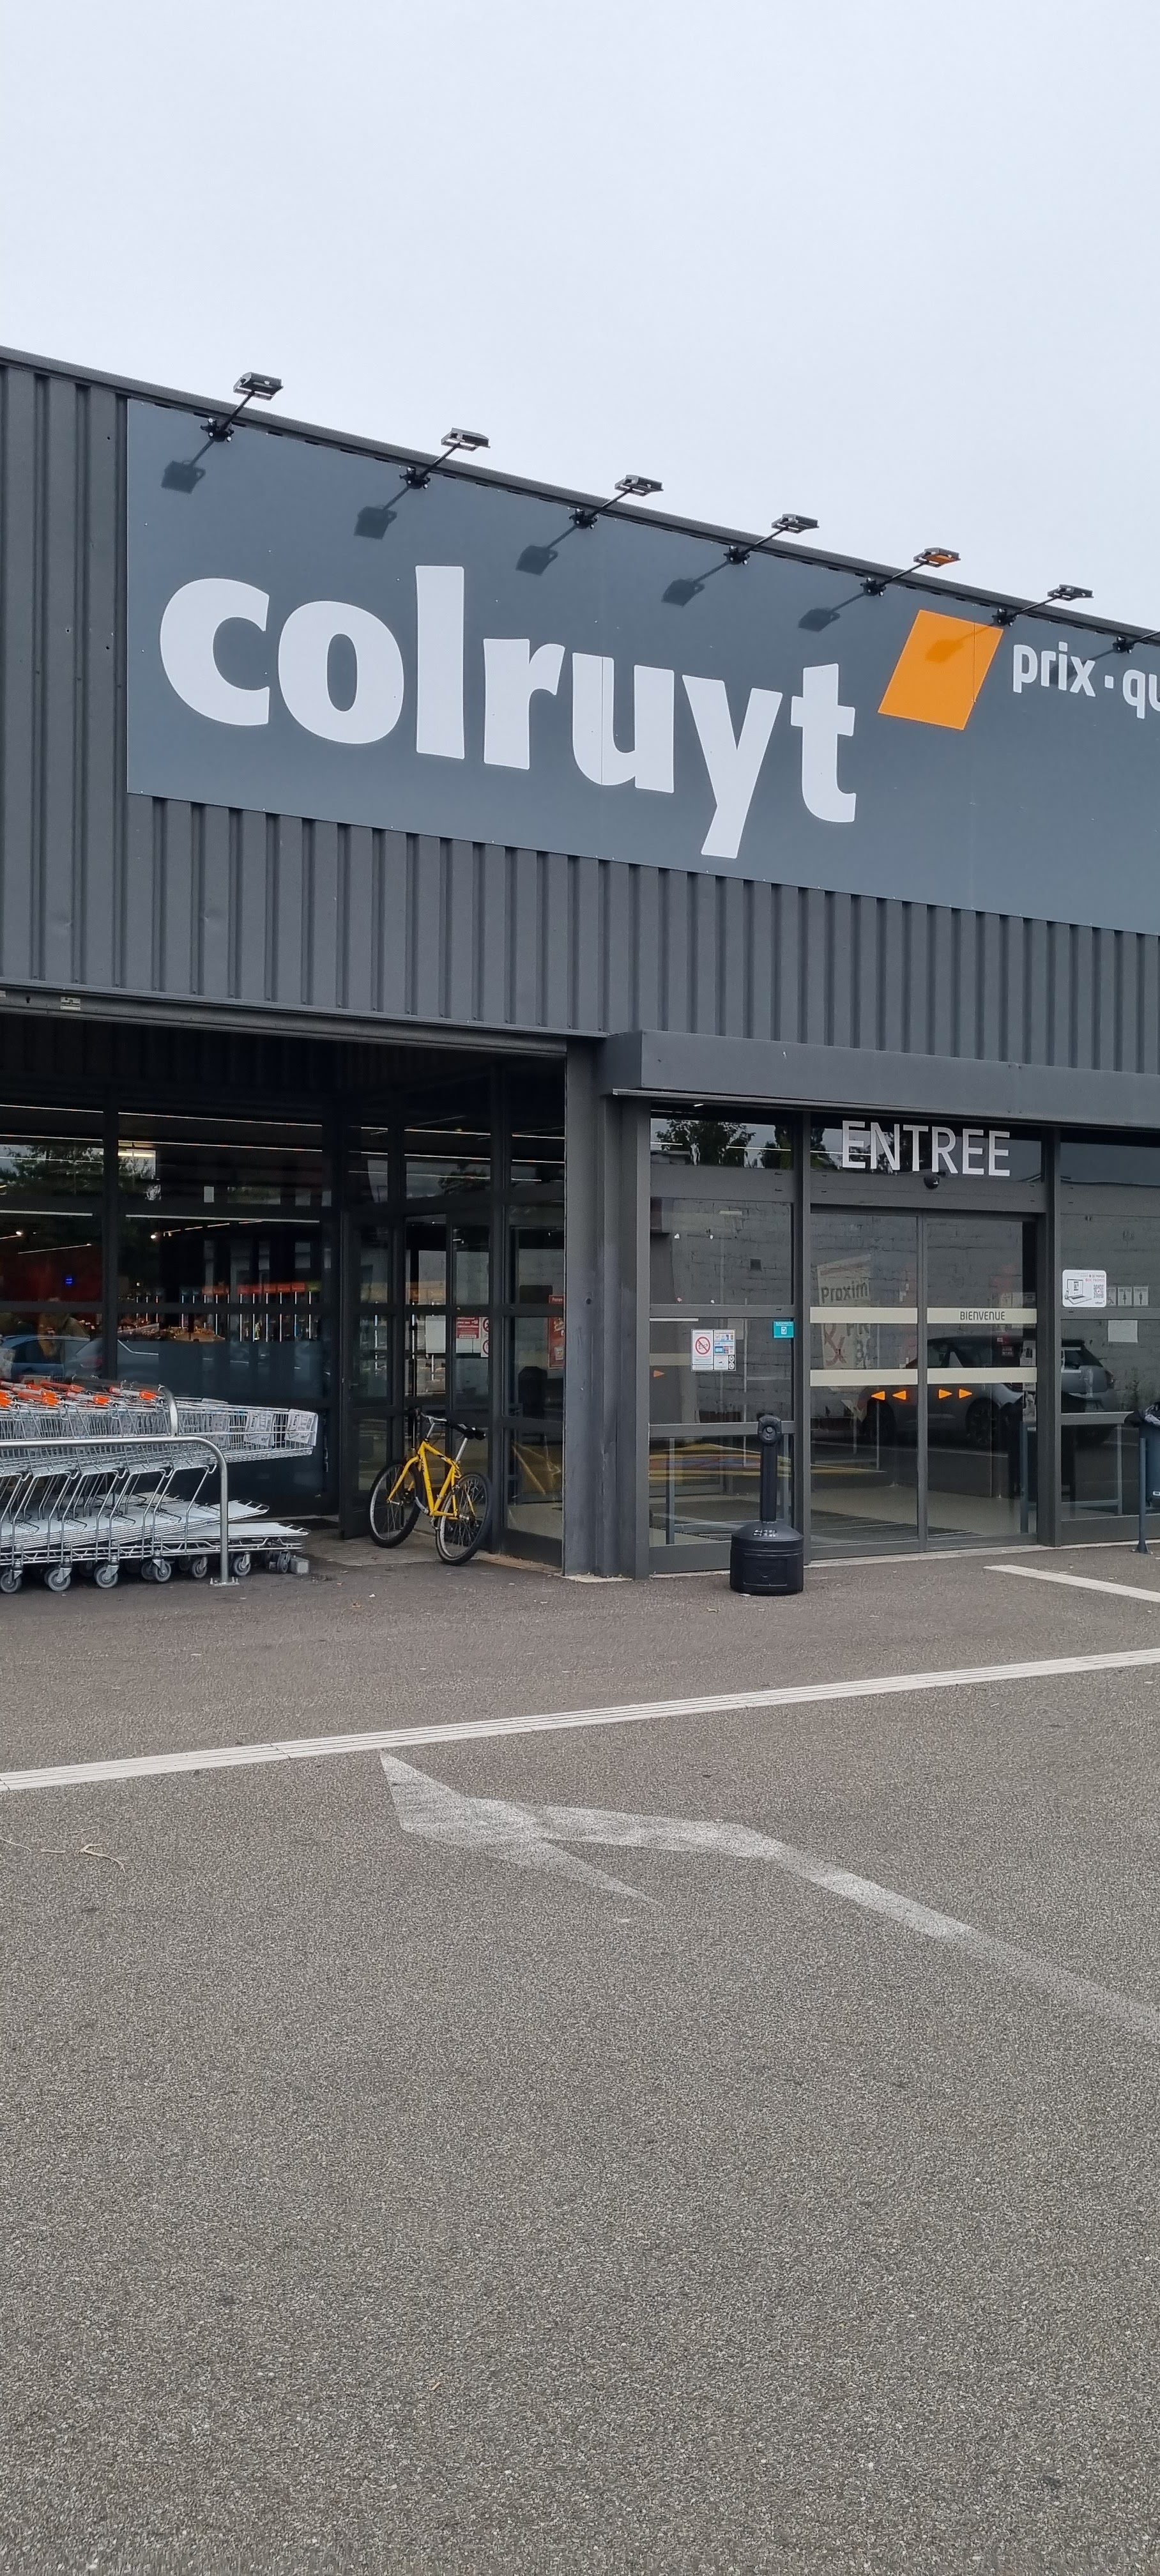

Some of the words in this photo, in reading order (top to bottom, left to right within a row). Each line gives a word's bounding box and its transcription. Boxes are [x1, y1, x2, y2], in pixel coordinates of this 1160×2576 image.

[1013, 641, 1095, 697] prix
[160, 566, 856, 859] colruyt
[842, 1120, 1010, 1177] ENTREE
